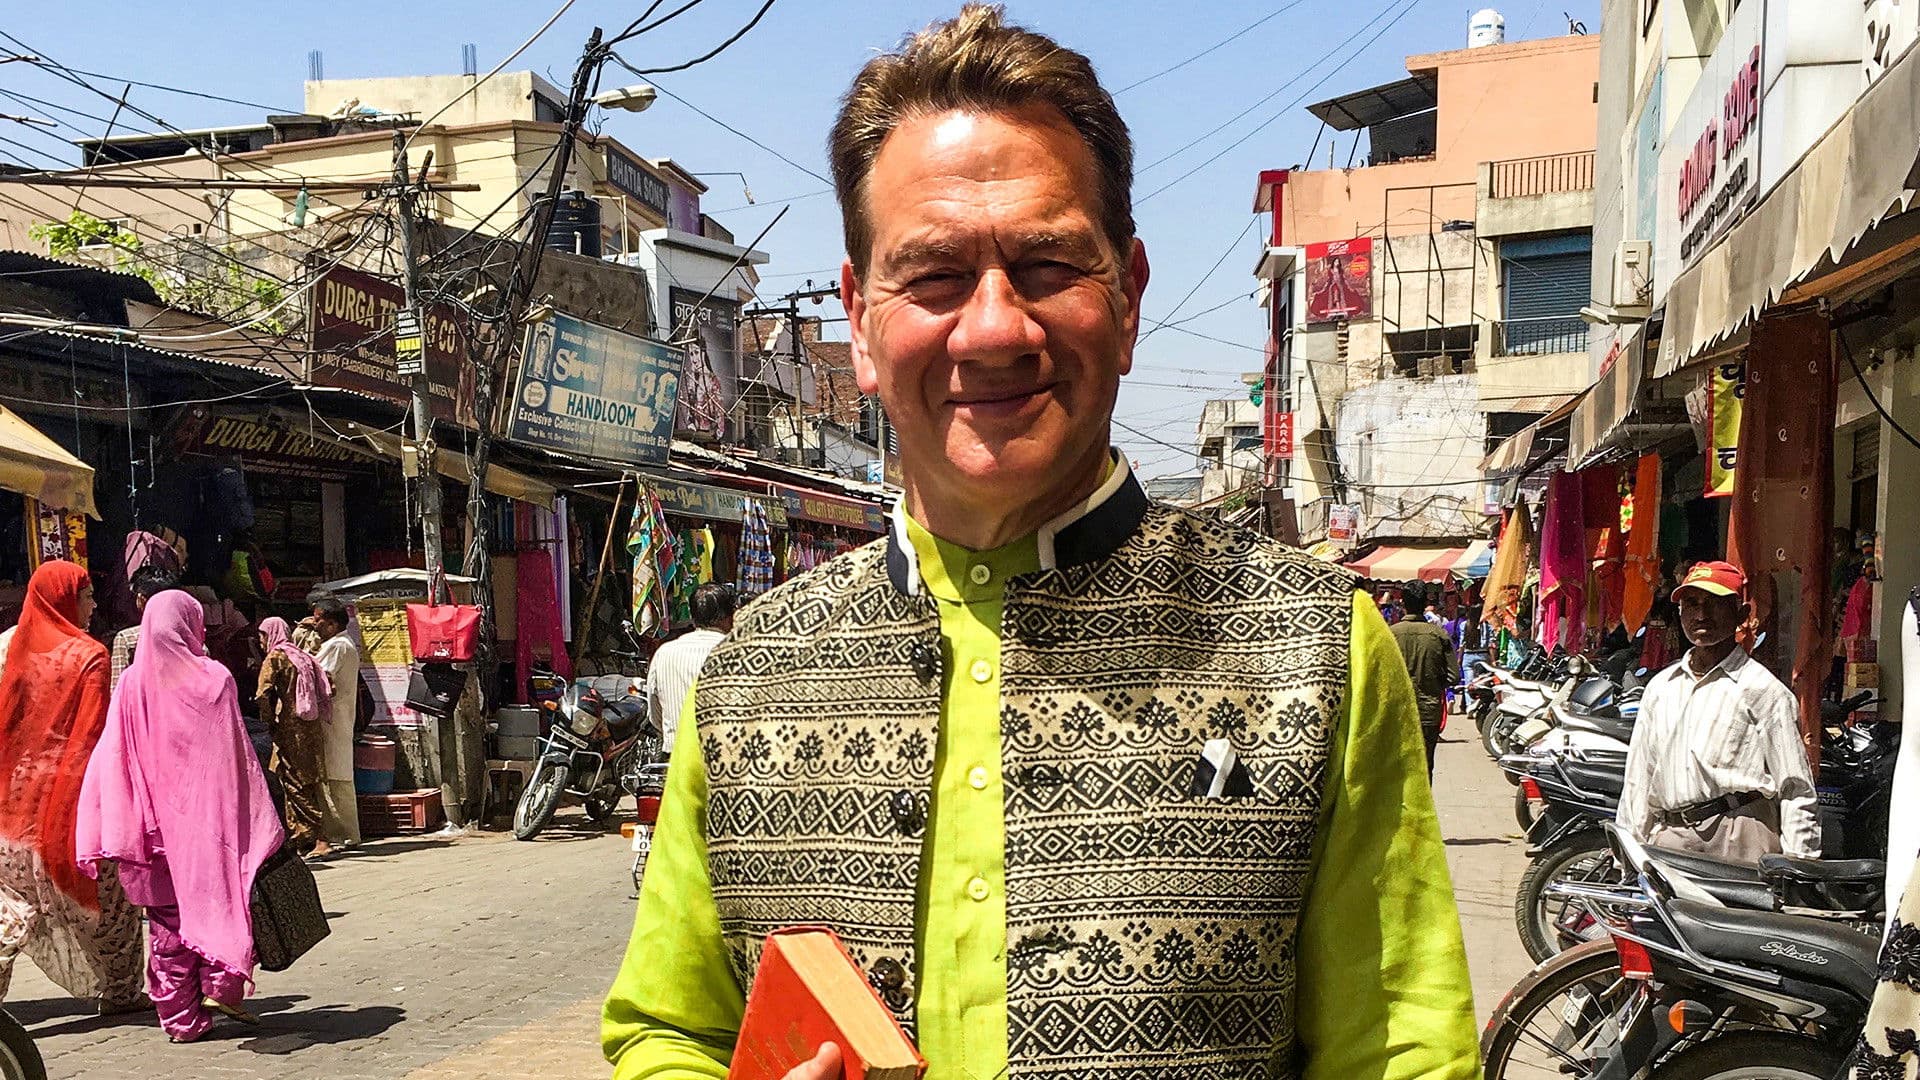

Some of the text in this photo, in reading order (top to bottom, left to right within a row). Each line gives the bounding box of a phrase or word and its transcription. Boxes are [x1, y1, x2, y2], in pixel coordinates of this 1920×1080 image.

[1722, 44, 1760, 160] BRIDE
[611, 154, 642, 198] BHATIA
[324, 279, 375, 329] DURGA
[518, 408, 552, 427] Exclusive
[566, 392, 637, 428] HANDLOOM
[204, 418, 277, 453] DURGA
[1280, 414, 1288, 452] PARAS
[1817, 791, 1843, 799] ERO
[1760, 942, 1828, 964] Splendor
